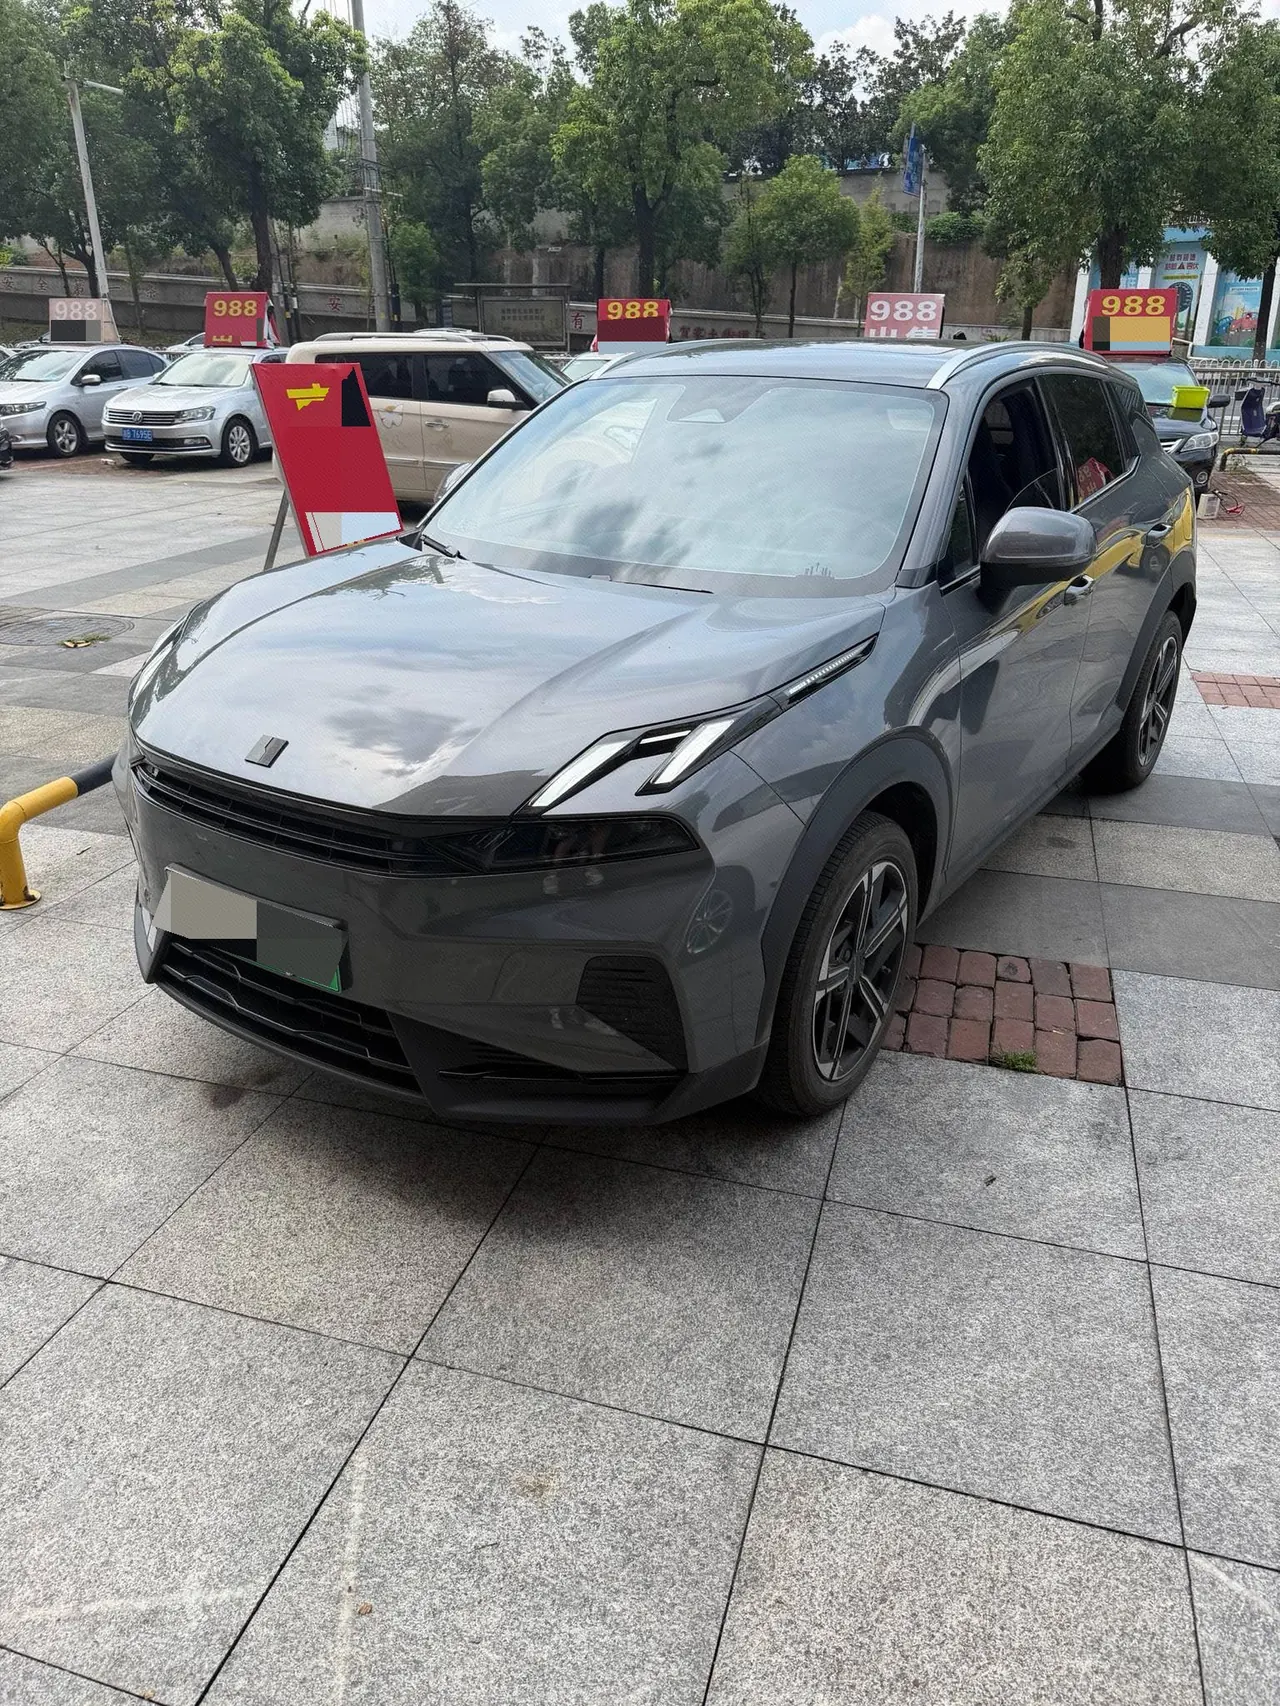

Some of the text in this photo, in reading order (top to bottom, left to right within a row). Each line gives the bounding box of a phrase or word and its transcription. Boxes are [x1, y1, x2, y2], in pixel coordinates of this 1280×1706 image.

[55, 300, 97, 320] 988
[213, 300, 257, 317] 988
[607, 301, 659, 320] 988
[870, 300, 937, 321] 988
[1101, 295, 1166, 316] 988
